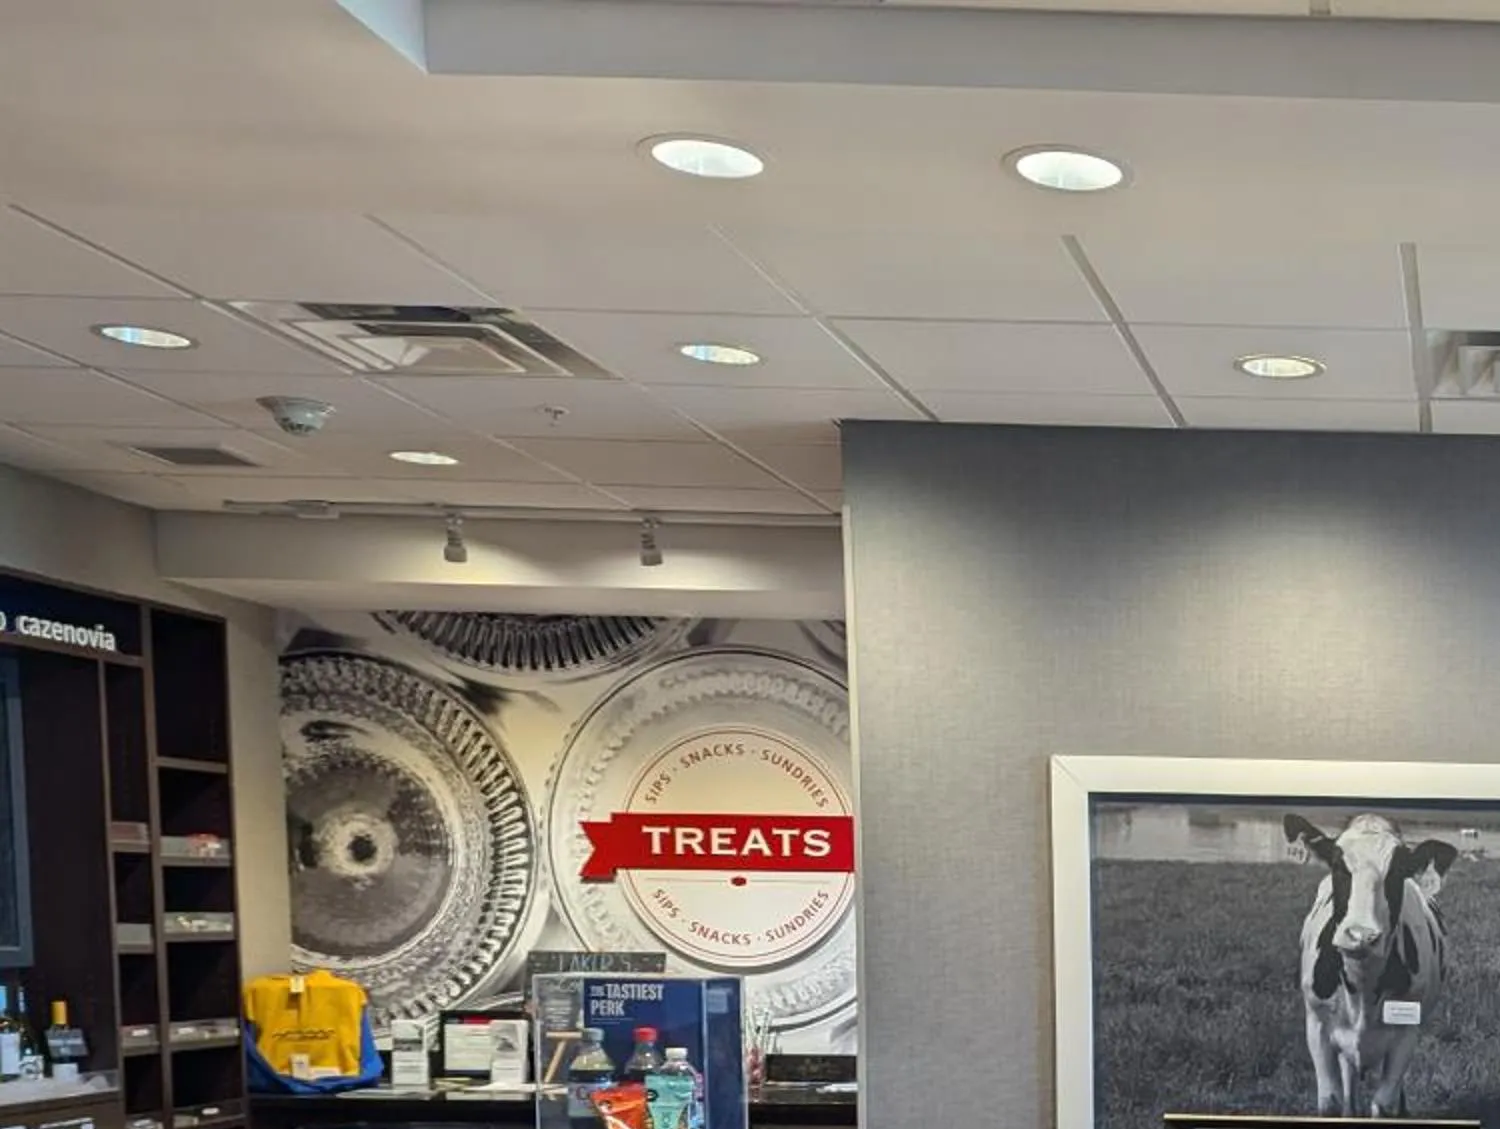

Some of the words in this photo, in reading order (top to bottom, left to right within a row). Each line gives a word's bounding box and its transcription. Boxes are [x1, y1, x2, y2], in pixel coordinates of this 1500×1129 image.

[19, 615, 116, 651] cazenovia
[645, 771, 672, 804] SIPS
[680, 743, 745, 768] SNACKS
[760, 749, 829, 808] SUNDRIES
[641, 825, 832, 857] TREATS
[652, 888, 681, 918] SIPS
[688, 920, 751, 945] SNACKS
[765, 889, 829, 943] SUNDRIES
[591, 1000, 625, 1017] PERK
[605, 983, 664, 1001] TASTIEST
